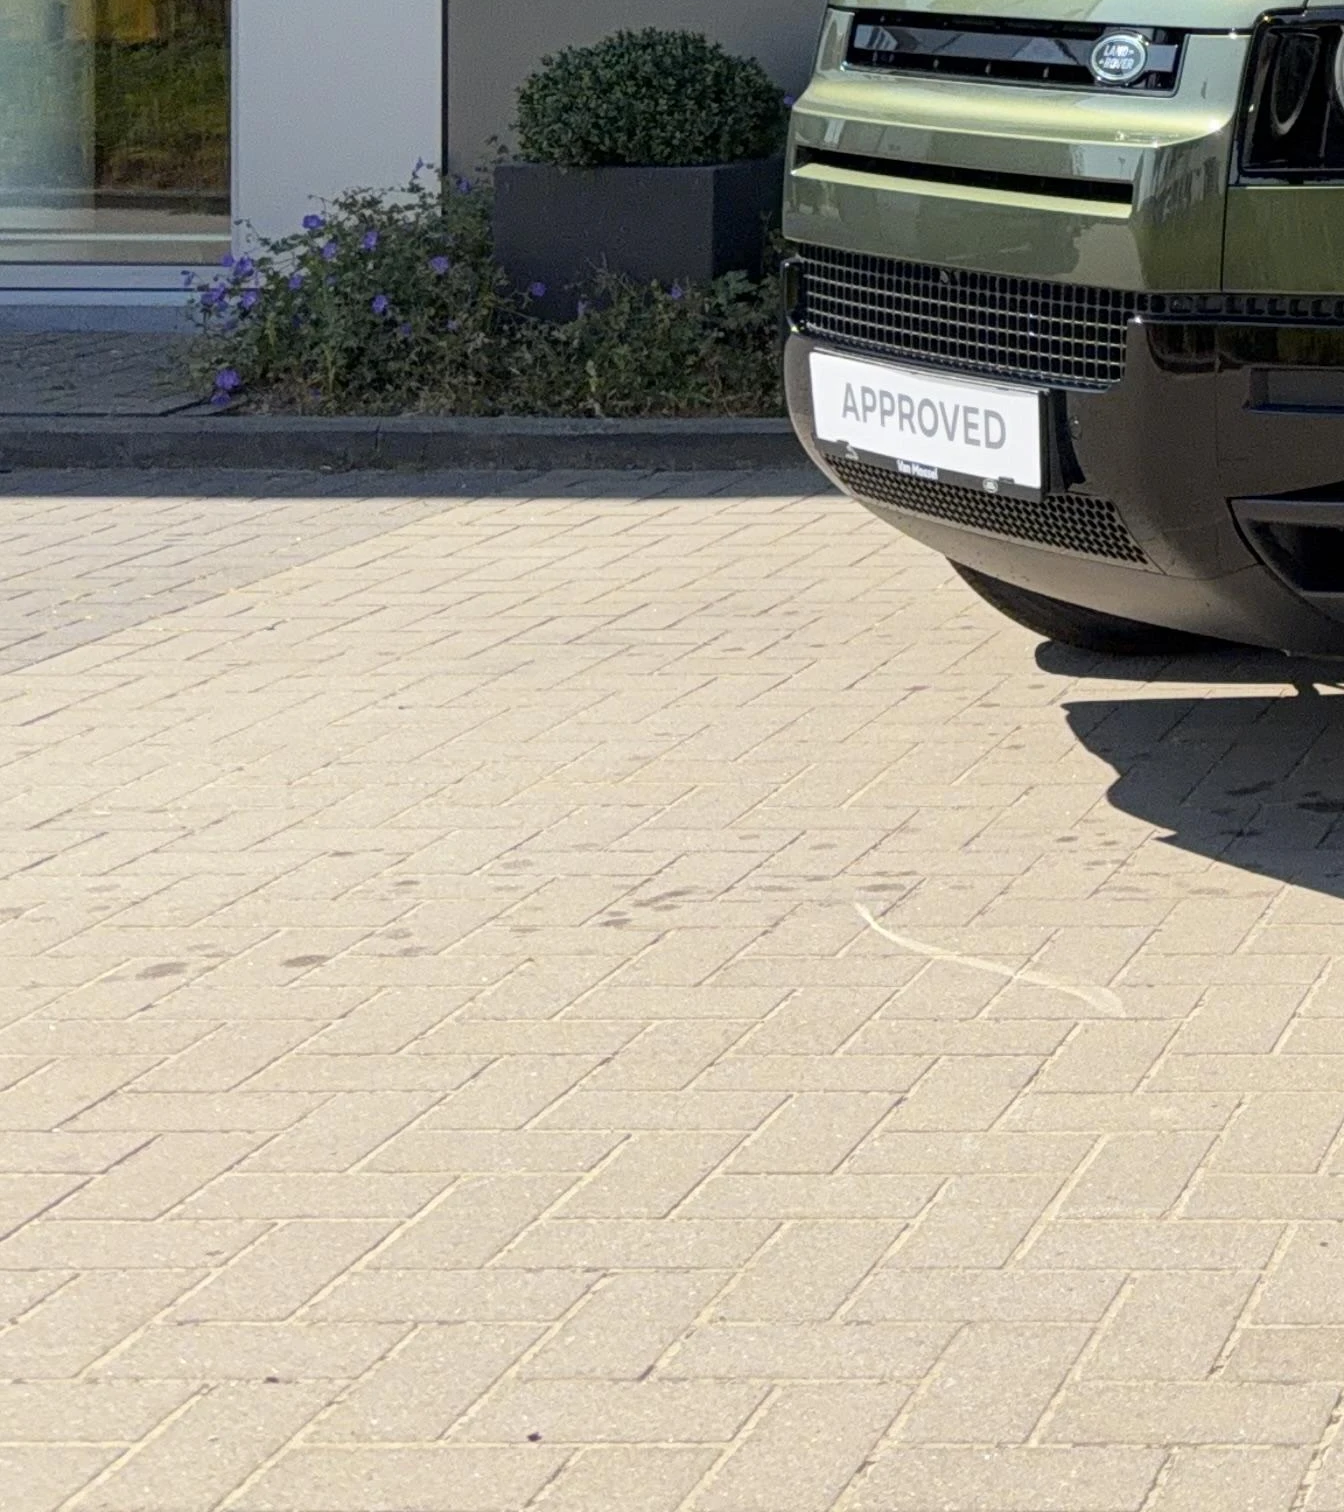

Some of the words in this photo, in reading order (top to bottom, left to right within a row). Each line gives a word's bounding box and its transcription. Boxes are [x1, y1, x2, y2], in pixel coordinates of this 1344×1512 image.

[1103, 44, 1129, 57] LAND
[1103, 57, 1134, 70] ROVER
[841, 382, 1006, 450] APPROVED
